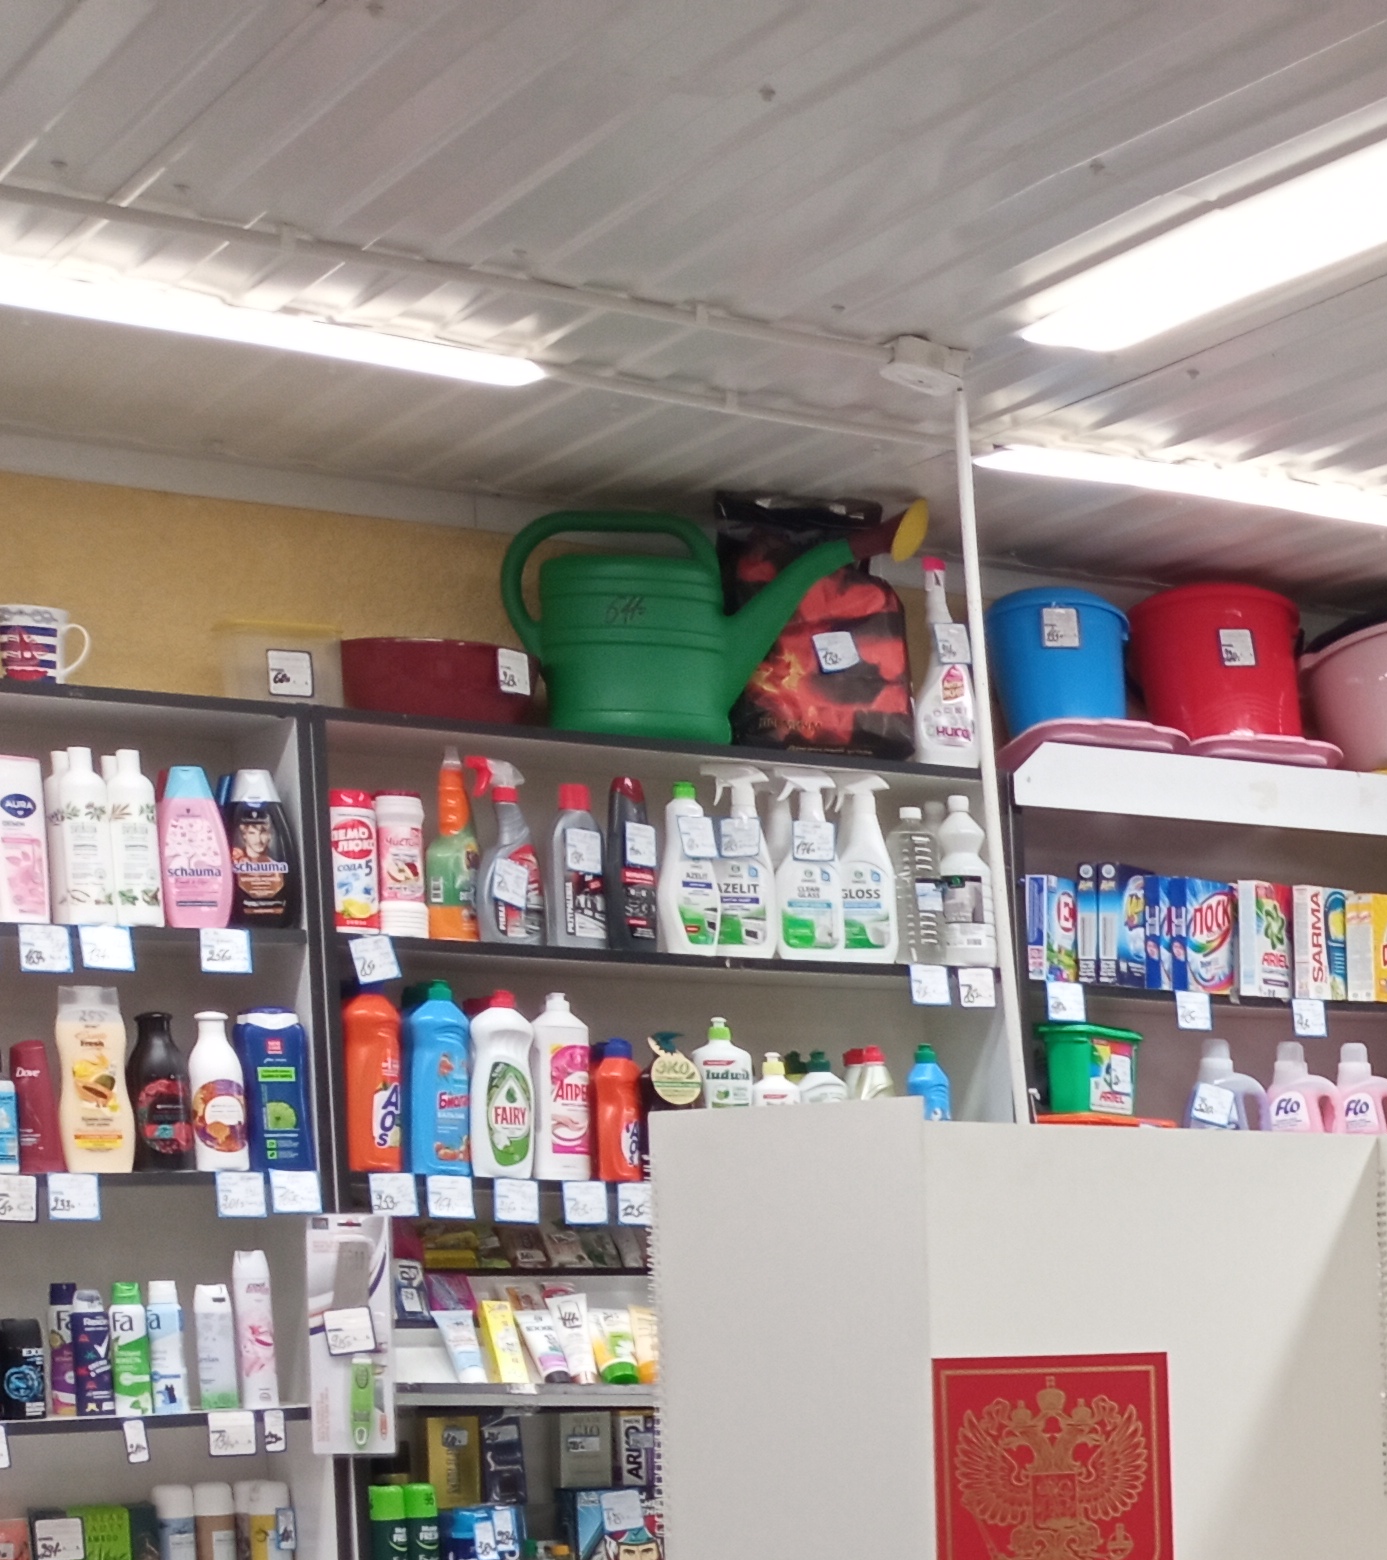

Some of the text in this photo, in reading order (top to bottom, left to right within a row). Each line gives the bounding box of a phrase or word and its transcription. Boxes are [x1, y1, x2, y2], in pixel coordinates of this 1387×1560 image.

[167, 865, 222, 879] schauma
[232, 860, 289, 874] schauma
[365, 859, 374, 877] 5
[1190, 895, 1232, 937] ЛОСК
[1310, 891, 1323, 984] SARMA
[1262, 952, 1290, 970] ARIEL
[16, 1066, 41, 1078] Dove
[494, 1106, 528, 1126] FAIRY
[1275, 1096, 1301, 1116] Flo
[1344, 1096, 1370, 1116] Flo
[112, 1311, 135, 1332] Fa
